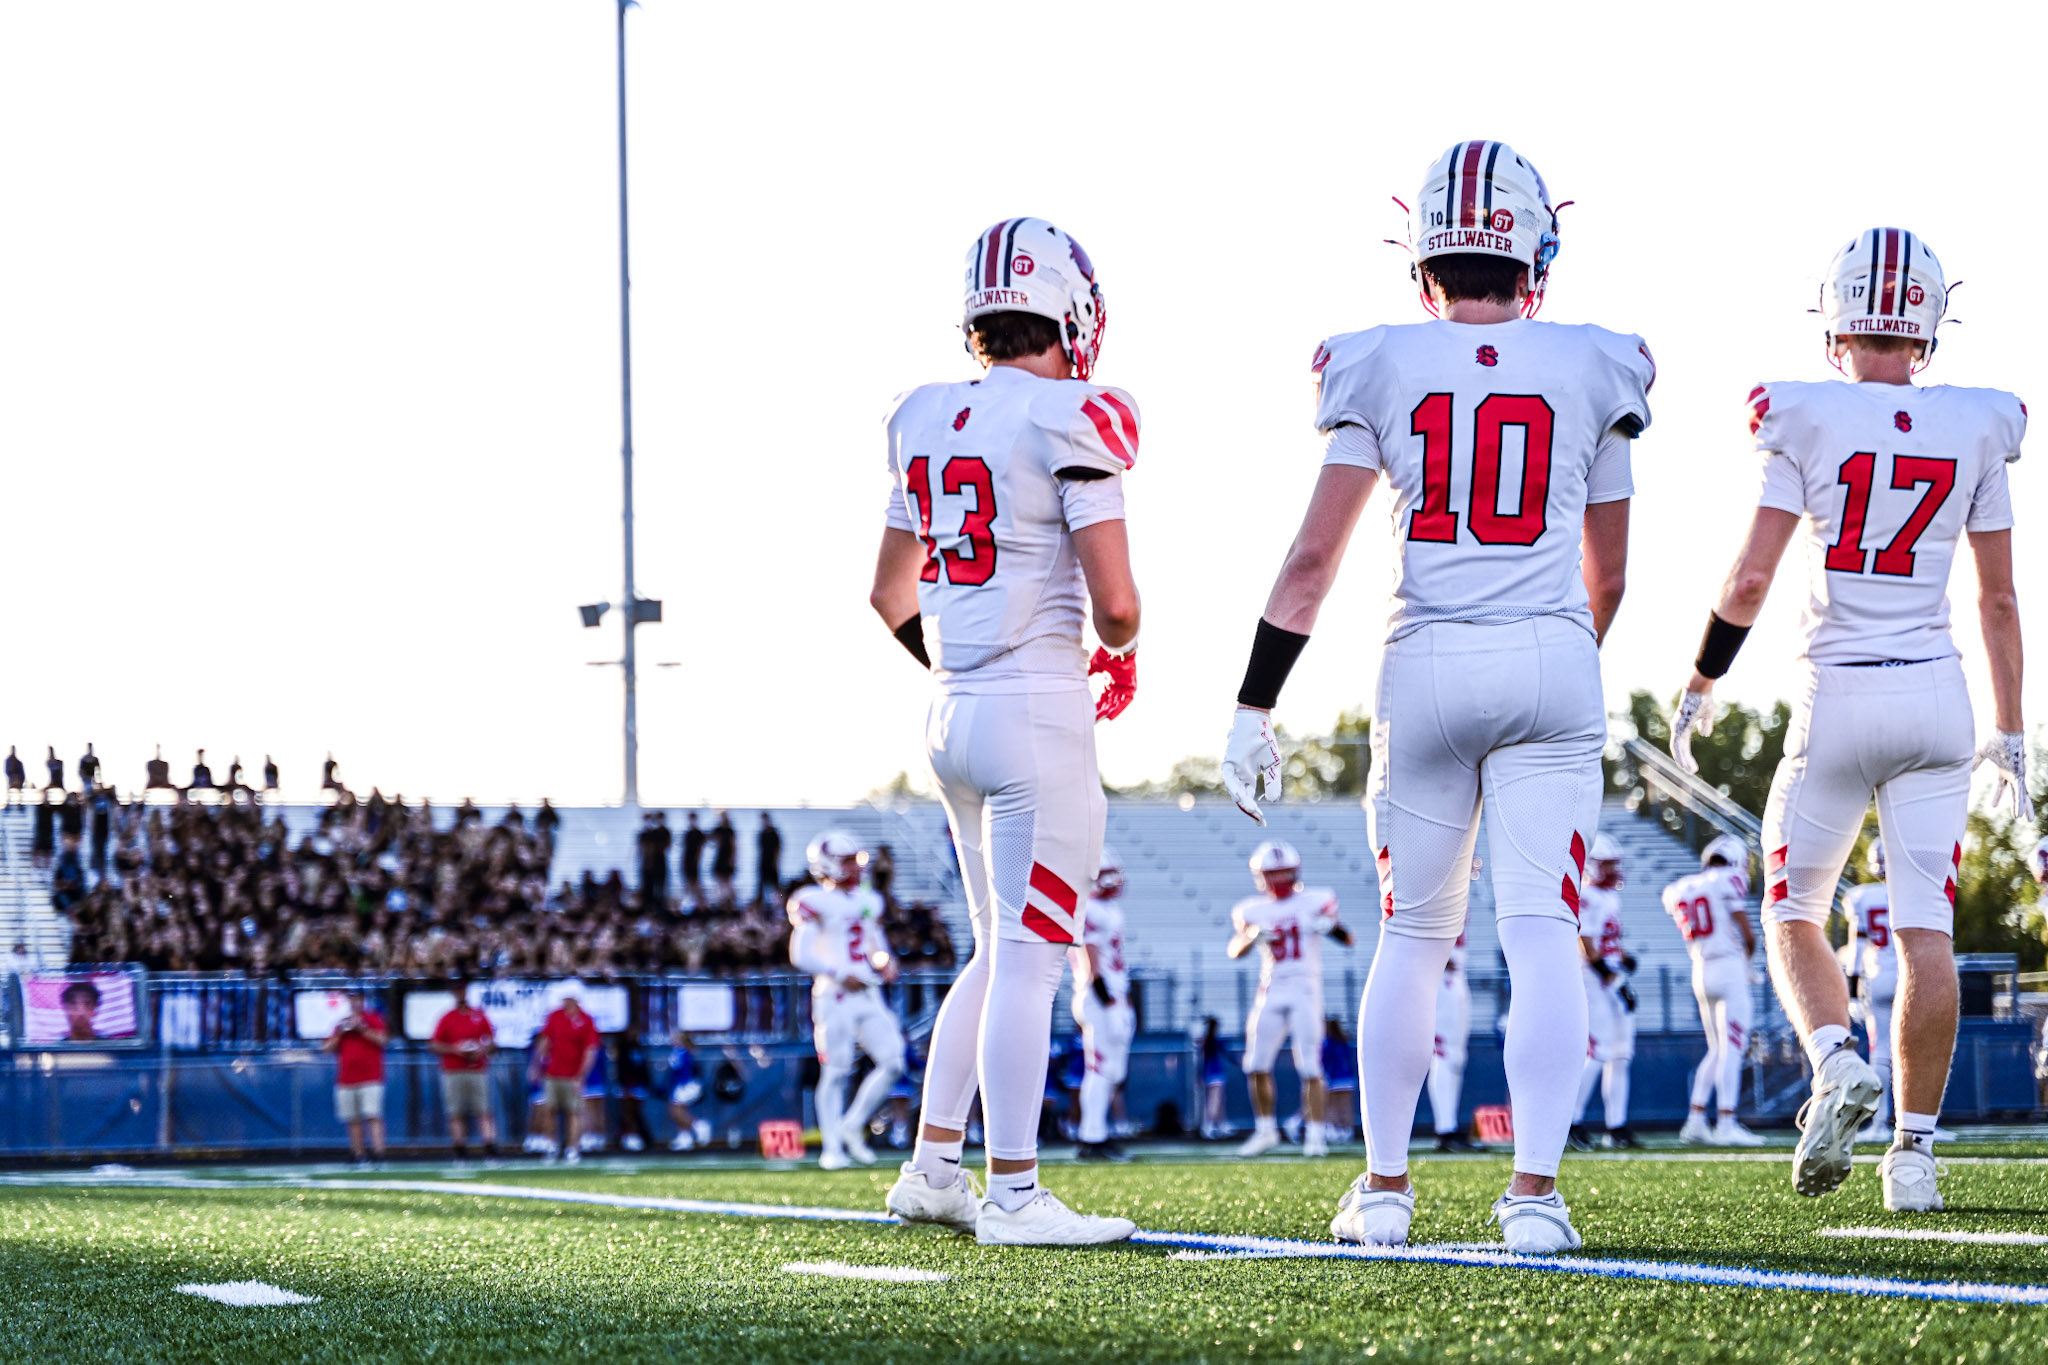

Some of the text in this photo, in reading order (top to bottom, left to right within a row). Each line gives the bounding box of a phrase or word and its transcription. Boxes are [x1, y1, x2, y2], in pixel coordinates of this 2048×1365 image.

[1430, 211, 1444, 226] 10
[1494, 213, 1512, 230] GT
[1428, 230, 1513, 253] STILLWATER
[1014, 258, 1032, 274] GT
[1852, 285, 1866, 299] 17
[1909, 287, 1923, 302] GT
[965, 289, 1030, 314] TILLWATER
[1850, 318, 1921, 335] STILLWATER
[1407, 392, 1555, 547] 10
[907, 455, 997, 587] 13
[1825, 451, 1958, 577] 17
